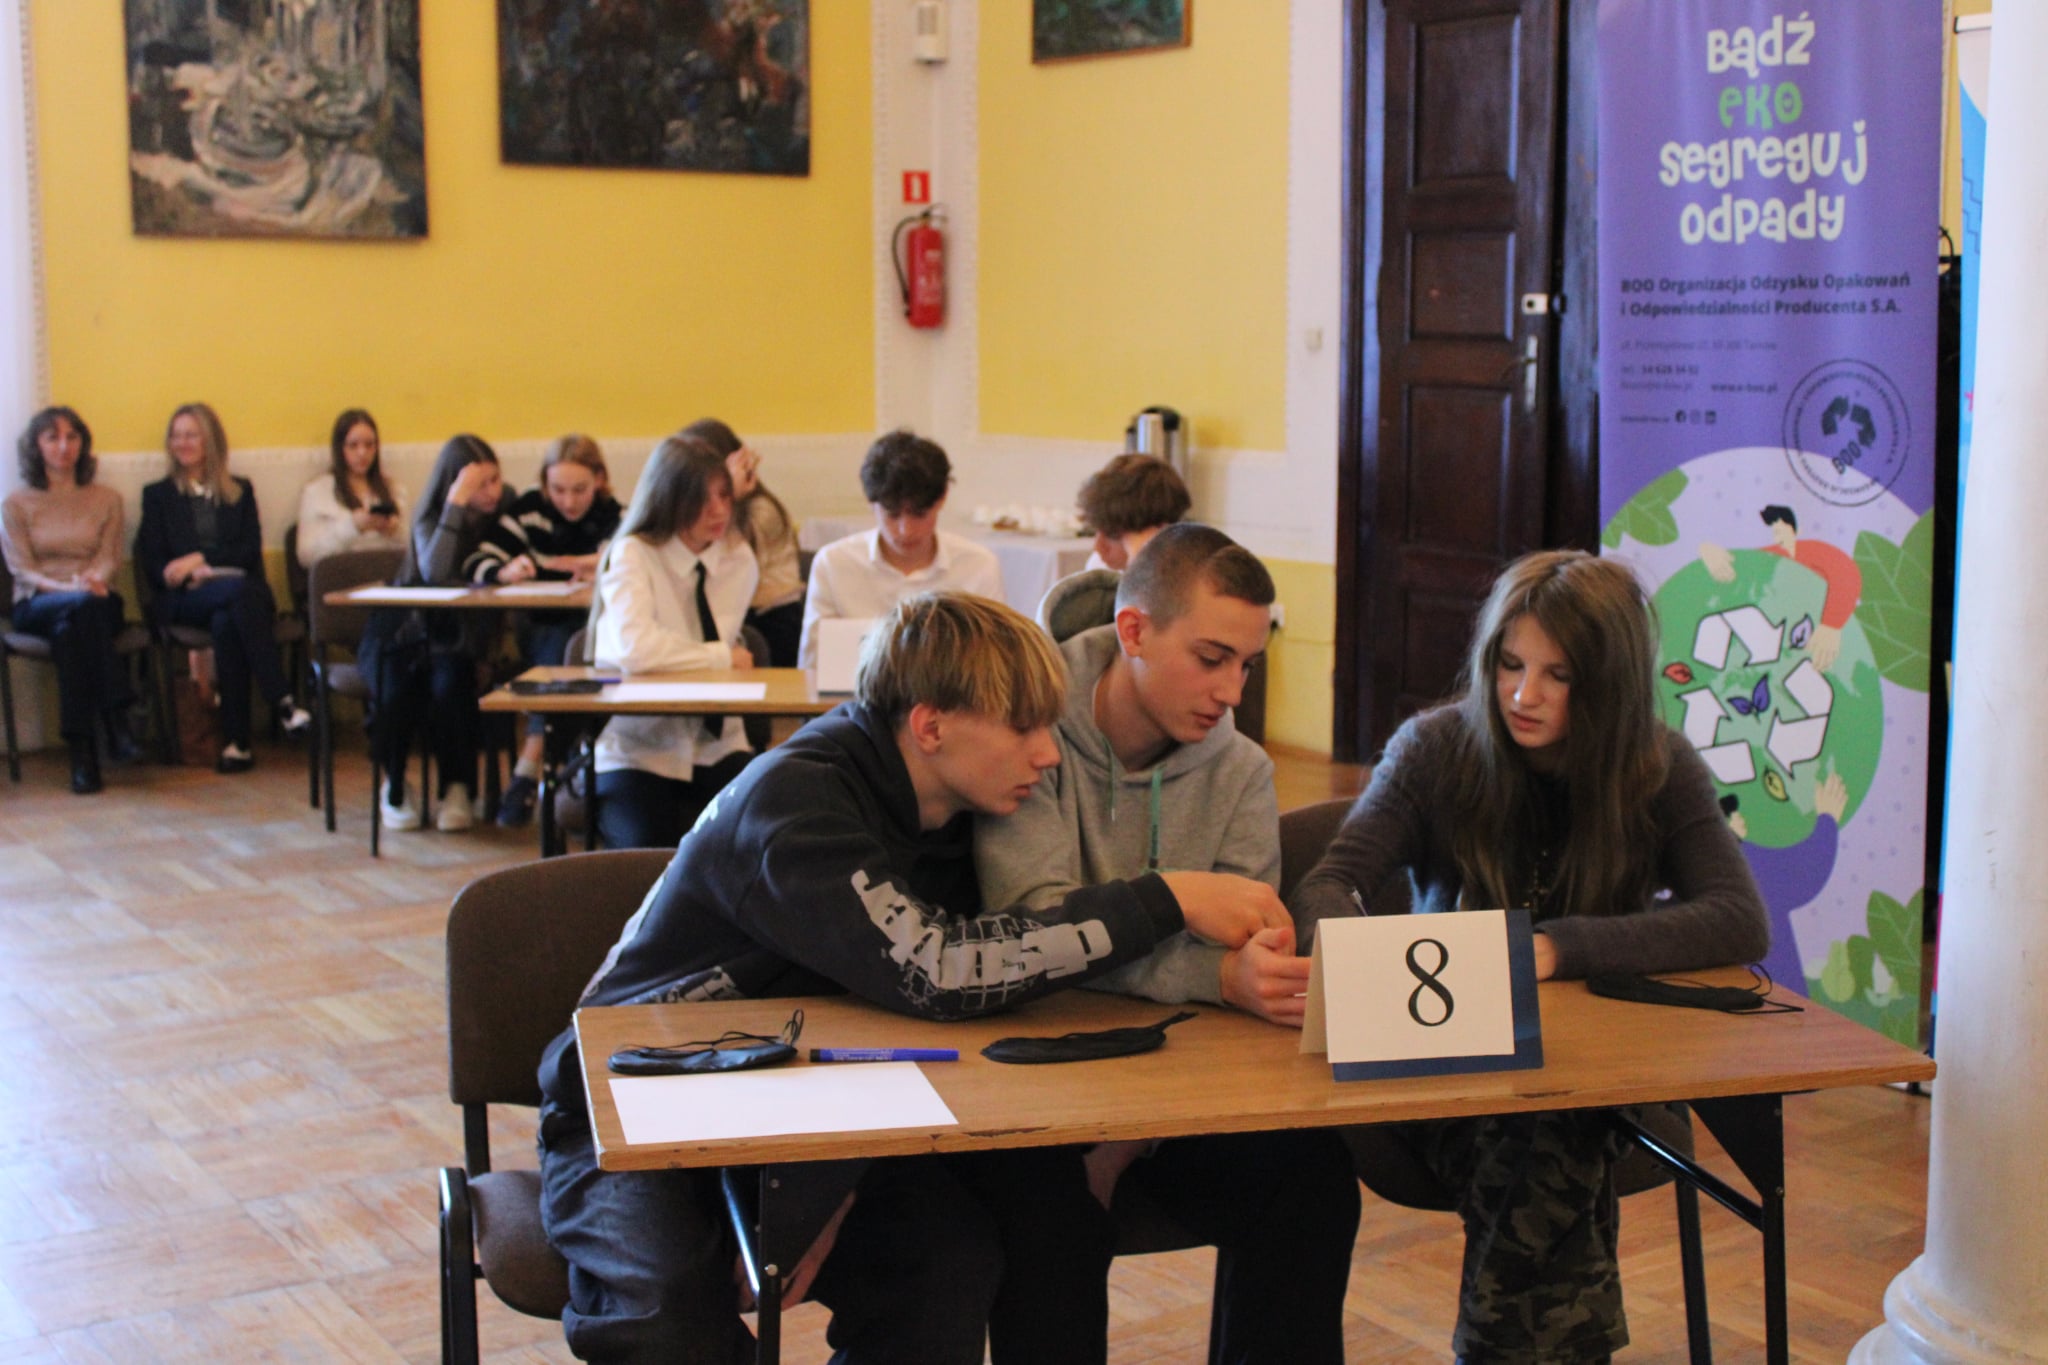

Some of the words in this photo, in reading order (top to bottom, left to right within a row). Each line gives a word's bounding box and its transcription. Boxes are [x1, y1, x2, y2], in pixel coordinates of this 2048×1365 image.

[1707, 11, 1816, 79] Bądź
[1659, 119, 1868, 188] segreguj
[1679, 189, 1846, 245] odpady
[1621, 278, 1654, 293] BOO
[1658, 277, 1748, 296] Organizacja
[1751, 274, 1820, 292] Odzysku
[1823, 272, 1911, 292] Opakowań
[1629, 300, 1771, 319] Odpowiedzialności
[1774, 299, 1868, 315] Producenta
[1870, 299, 1902, 314] S.A.
[1832, 441, 1862, 476] BOO
[1405, 938, 1455, 1027] 8
